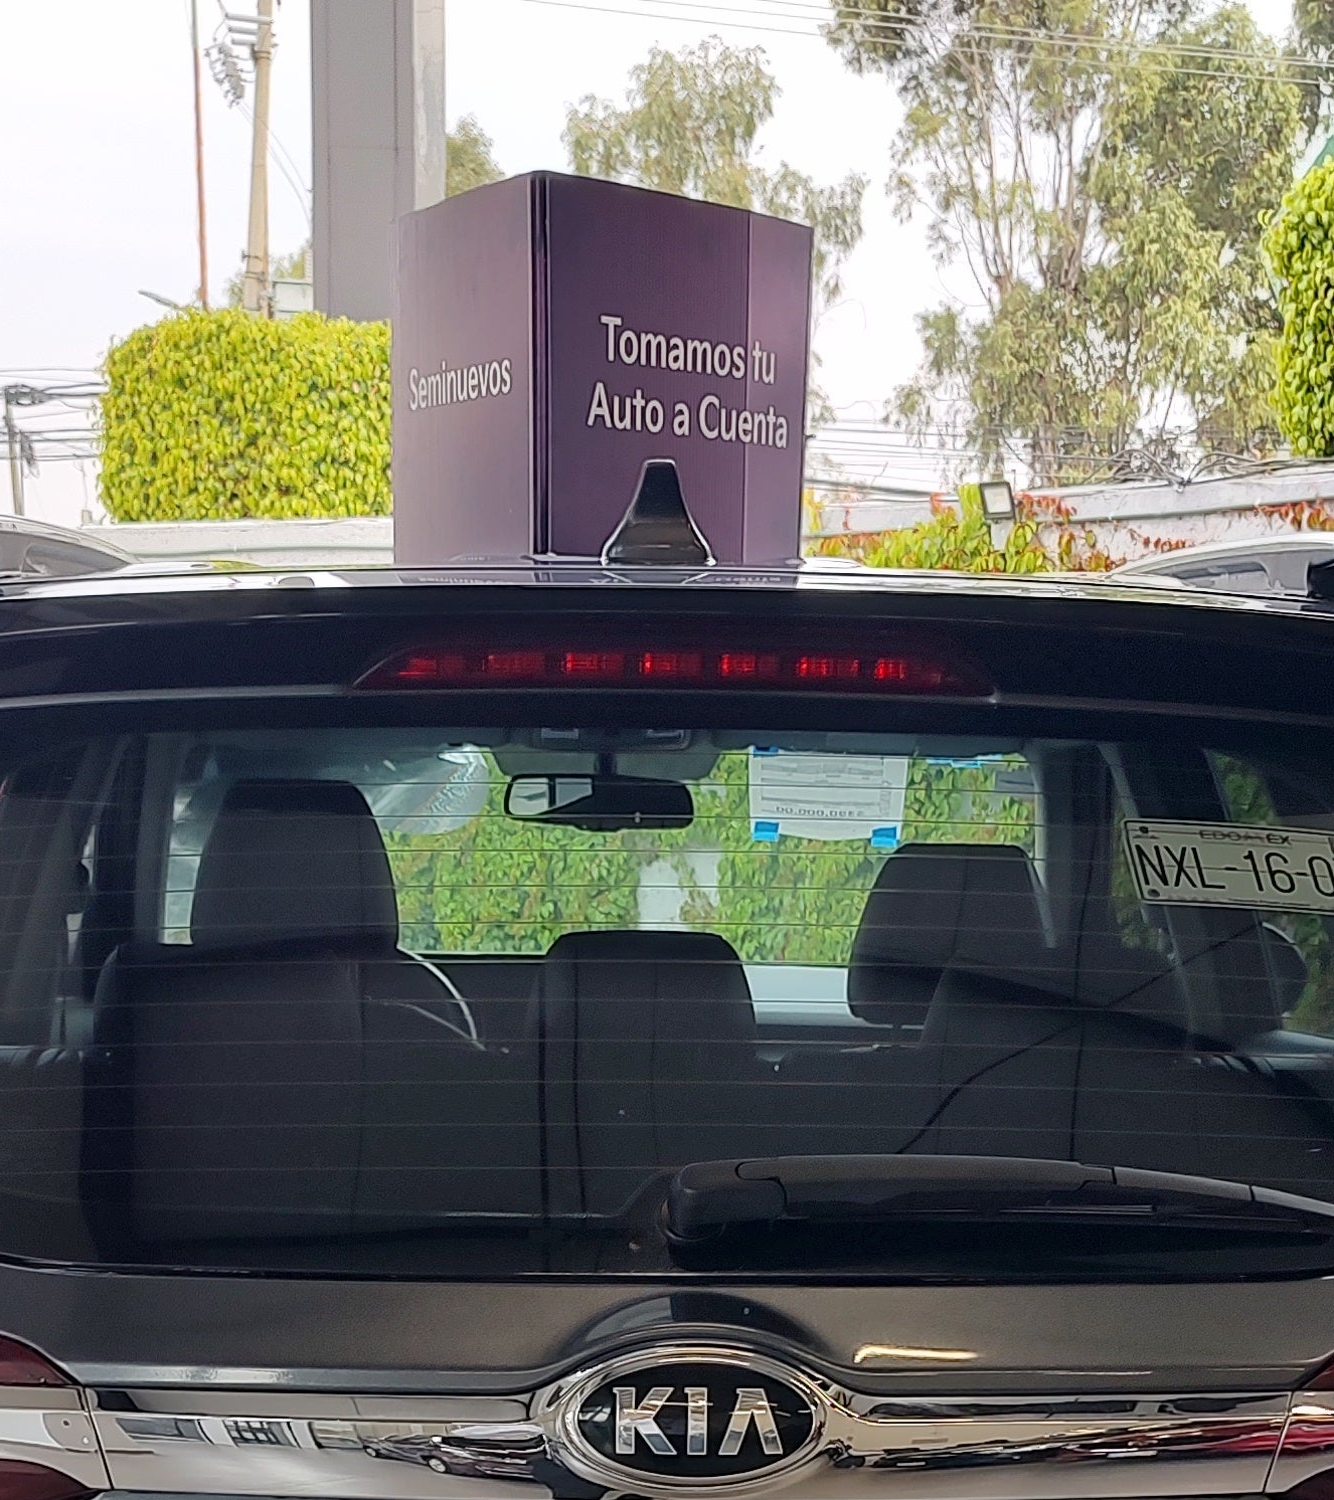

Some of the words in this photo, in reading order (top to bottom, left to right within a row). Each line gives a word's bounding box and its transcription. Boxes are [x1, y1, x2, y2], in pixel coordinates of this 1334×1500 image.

[408, 357, 512, 411] Seminuevos
[600, 315, 746, 378] Tomamos
[751, 340, 776, 385] tu
[587, 381, 665, 434] Auto
[673, 402, 691, 436] a
[698, 398, 788, 449] Cuenta
[613, 1386, 784, 1456] KIA
